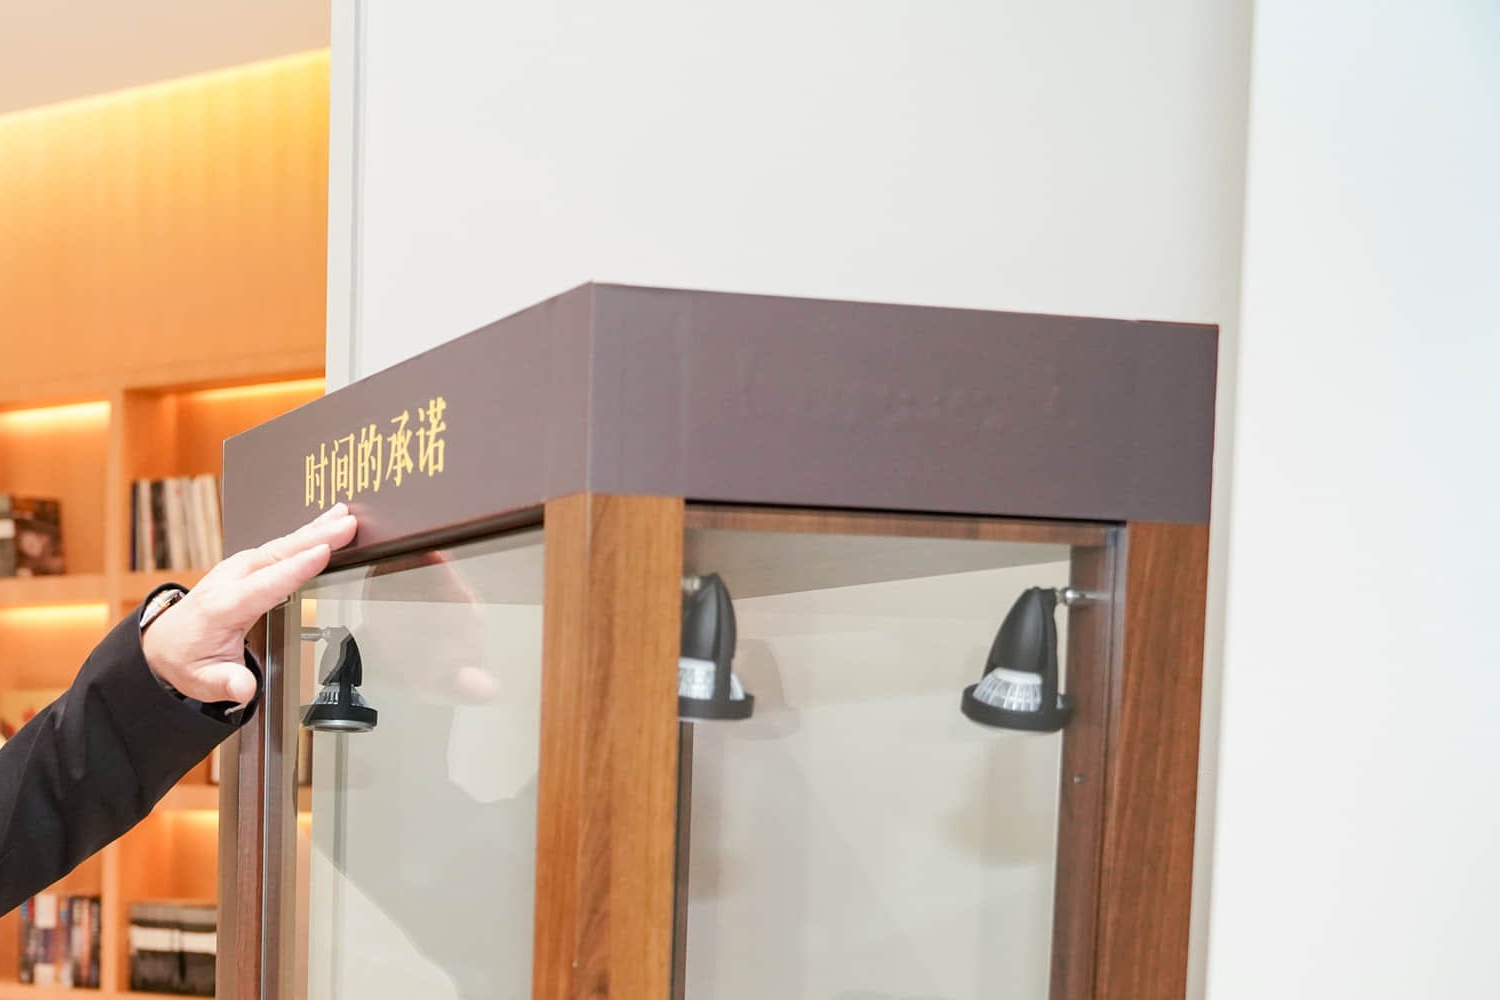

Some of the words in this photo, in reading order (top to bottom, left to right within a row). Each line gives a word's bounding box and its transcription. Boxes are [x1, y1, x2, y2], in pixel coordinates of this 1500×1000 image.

[304, 397, 446, 509] 时间的承诺
